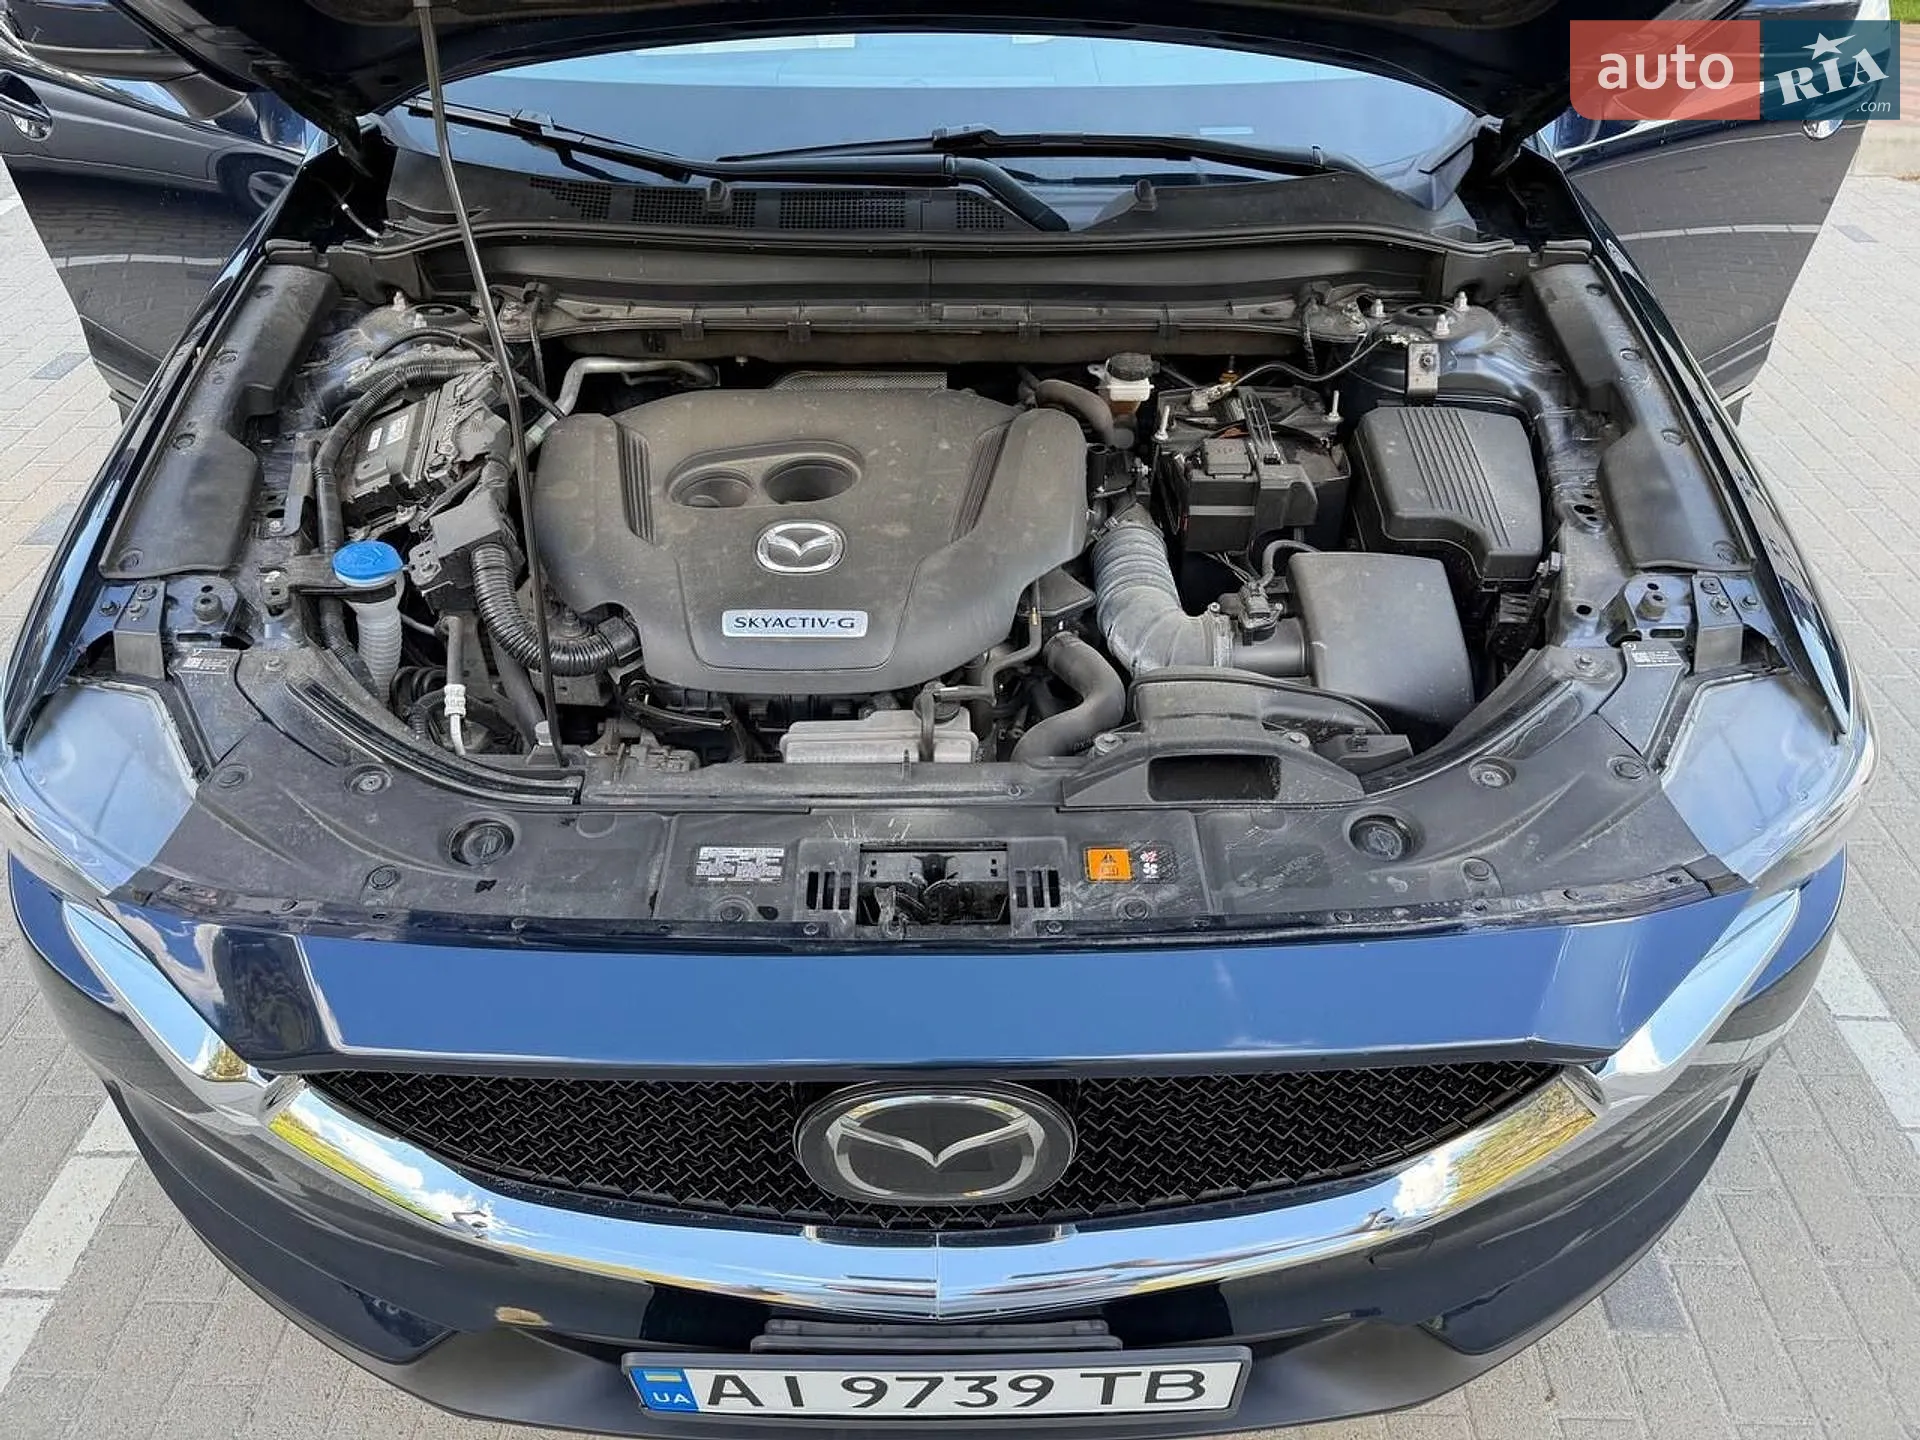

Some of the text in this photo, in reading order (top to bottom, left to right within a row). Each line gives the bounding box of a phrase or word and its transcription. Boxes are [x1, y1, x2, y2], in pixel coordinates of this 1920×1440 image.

[733, 616, 855, 629] SKYACTIV-G
[707, 1369, 1206, 1409] AI 9739 TB
[652, 1391, 691, 1404] UA
